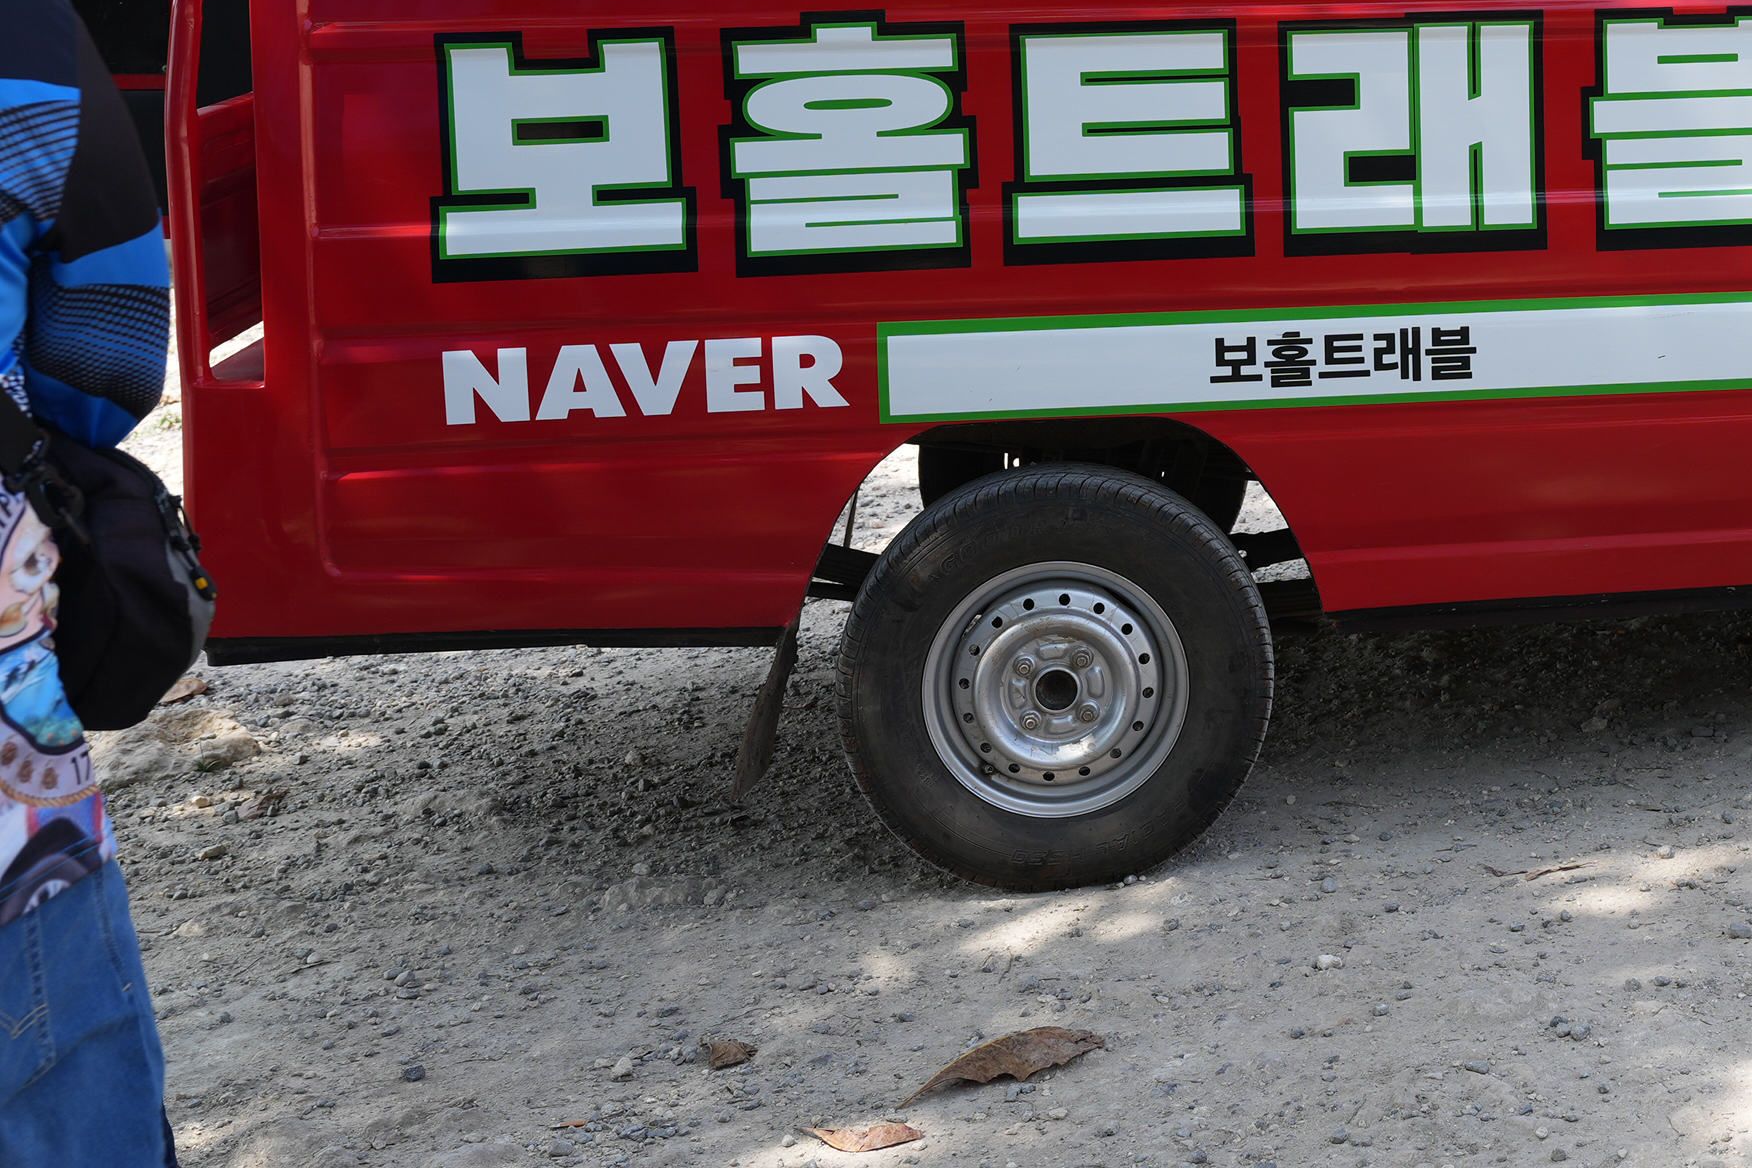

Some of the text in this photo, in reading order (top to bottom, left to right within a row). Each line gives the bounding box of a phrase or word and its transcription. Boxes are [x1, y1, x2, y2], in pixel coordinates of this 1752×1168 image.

[441, 334, 851, 427] NAVER
[1209, 326, 1478, 389] 보홀트래블
[938, 519, 1114, 577] GOODRIDE
[1095, 794, 1188, 856] RADIAL
